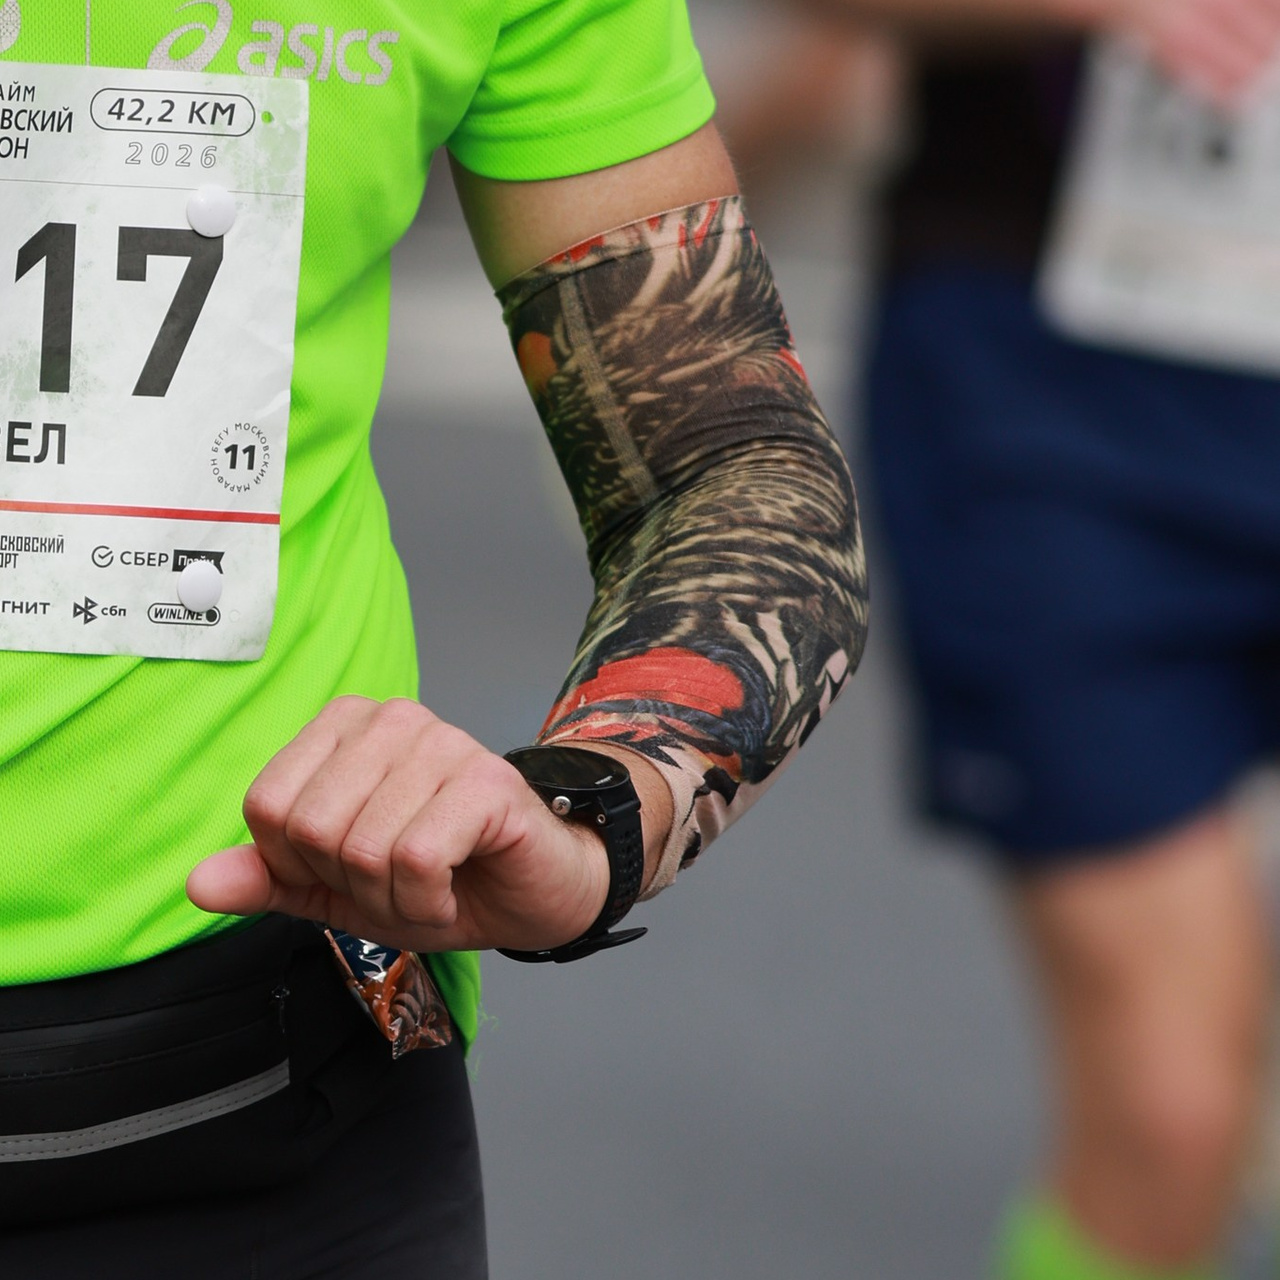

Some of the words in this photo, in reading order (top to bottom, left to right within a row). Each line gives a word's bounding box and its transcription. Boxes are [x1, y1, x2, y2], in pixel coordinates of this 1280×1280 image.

[237, 20, 401, 86] asics
[107, 97, 175, 126] 42,2
[187, 100, 236, 127] КМ
[125, 141, 218, 169] 2026
[211, 427, 229, 453] БЕГУ
[234, 422, 270, 485] МОСКОВСКИЙ
[224, 443, 256, 471] 11
[210, 458, 251, 493] МАРАФОН
[119, 551, 169, 567] СБЕР
[101, 605, 127, 617] сбп
[154, 607, 203, 621] WINLINE
